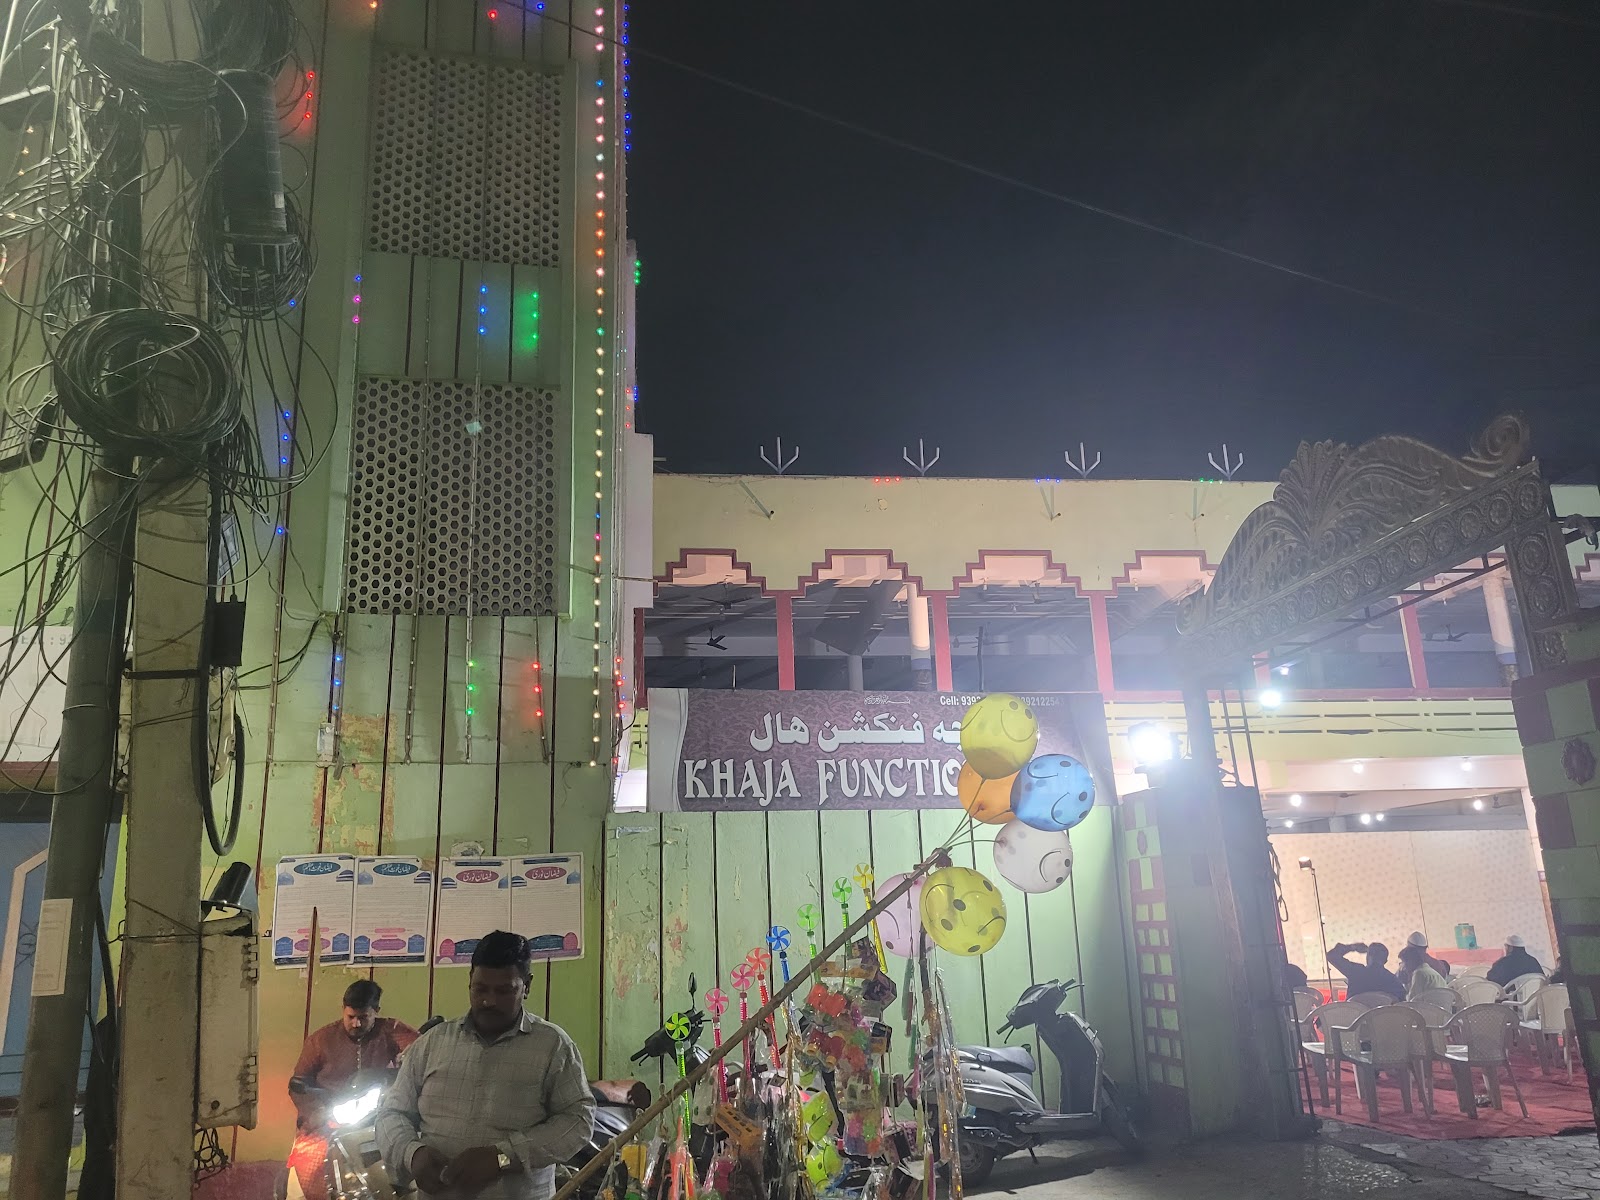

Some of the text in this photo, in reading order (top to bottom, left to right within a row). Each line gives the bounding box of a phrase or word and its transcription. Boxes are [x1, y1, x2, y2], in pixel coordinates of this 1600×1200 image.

[940, 695, 959, 706] Cell:
[683, 757, 967, 807] KHAJA FUNCTIO
